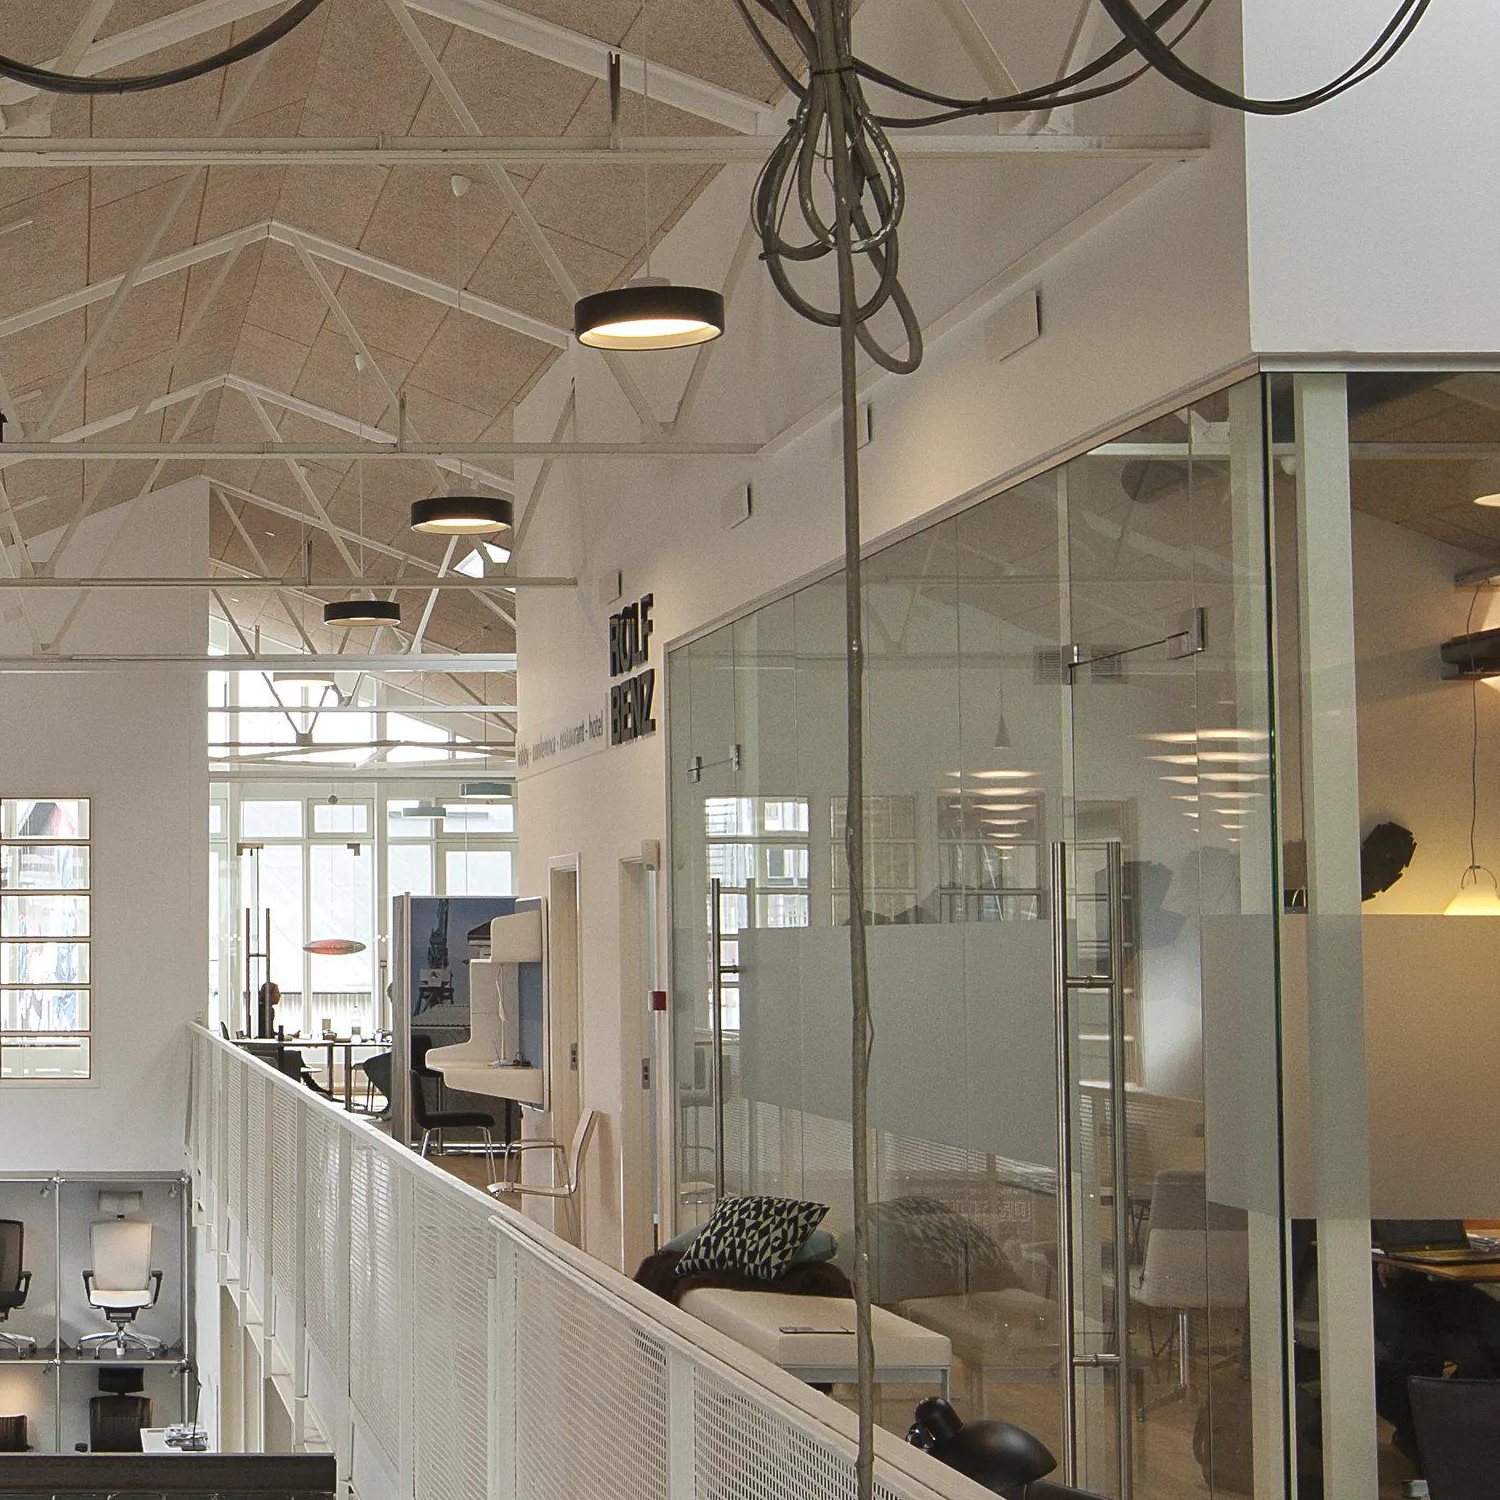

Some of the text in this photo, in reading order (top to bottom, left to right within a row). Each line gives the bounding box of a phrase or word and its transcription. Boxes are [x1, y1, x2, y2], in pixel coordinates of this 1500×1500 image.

[609, 592, 654, 677] ROLF
[588, 709, 604, 740] hotel
[610, 668, 656, 746] BENZ
